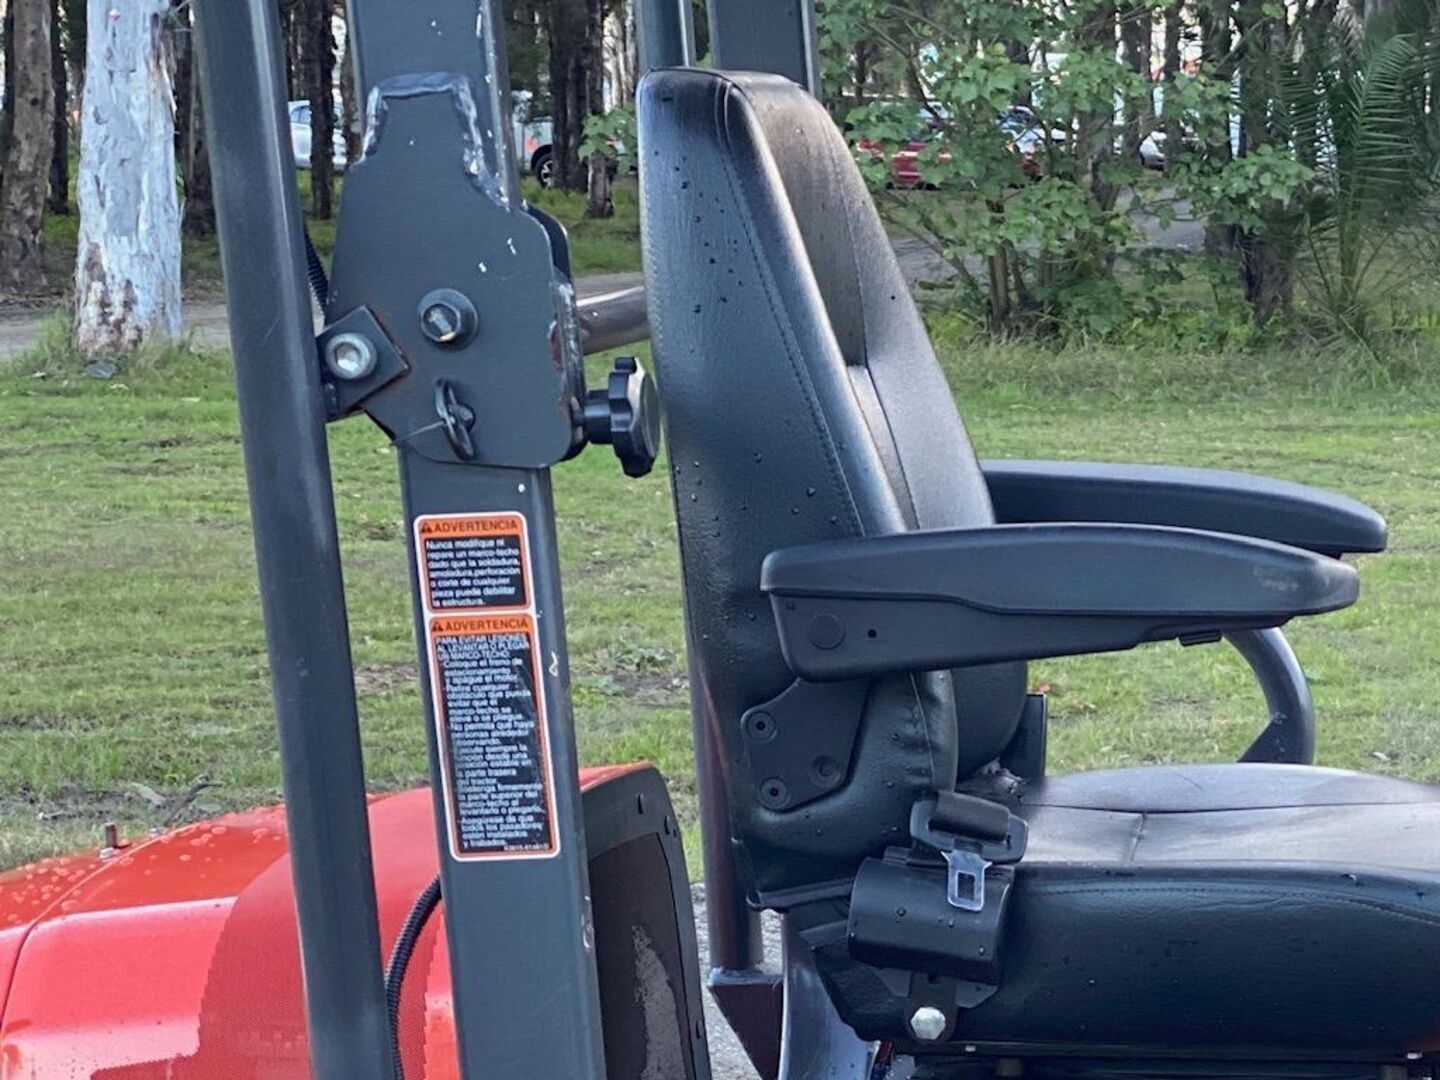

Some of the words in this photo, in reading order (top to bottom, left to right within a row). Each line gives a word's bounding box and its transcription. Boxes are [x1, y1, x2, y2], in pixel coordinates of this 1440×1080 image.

[435, 520, 517, 532] ADVERTENCIA
[426, 541, 453, 549] Nunca
[454, 539, 494, 548] modifique
[496, 538, 505, 546] ni
[427, 551, 453, 560] repare
[468, 548, 519, 557] marco-techo
[428, 560, 449, 568] dado
[450, 560, 466, 568] que
[460, 578, 471, 586] de
[473, 577, 510, 586] cualquier
[432, 589, 453, 599] pieza
[456, 588, 481, 597] puede
[483, 586, 515, 596] debilitar
[445, 618, 528, 631] ADVERTENCIA
[459, 635, 487, 643] EVITAR
[488, 633, 527, 643] LESIONES
[437, 644, 446, 652] AL
[448, 643, 488, 651] LEVANTAR
[498, 641, 529, 649] PLEGAR
[438, 652, 448, 661] UN
[488, 690, 503, 698] que
[496, 721, 512, 729] que
